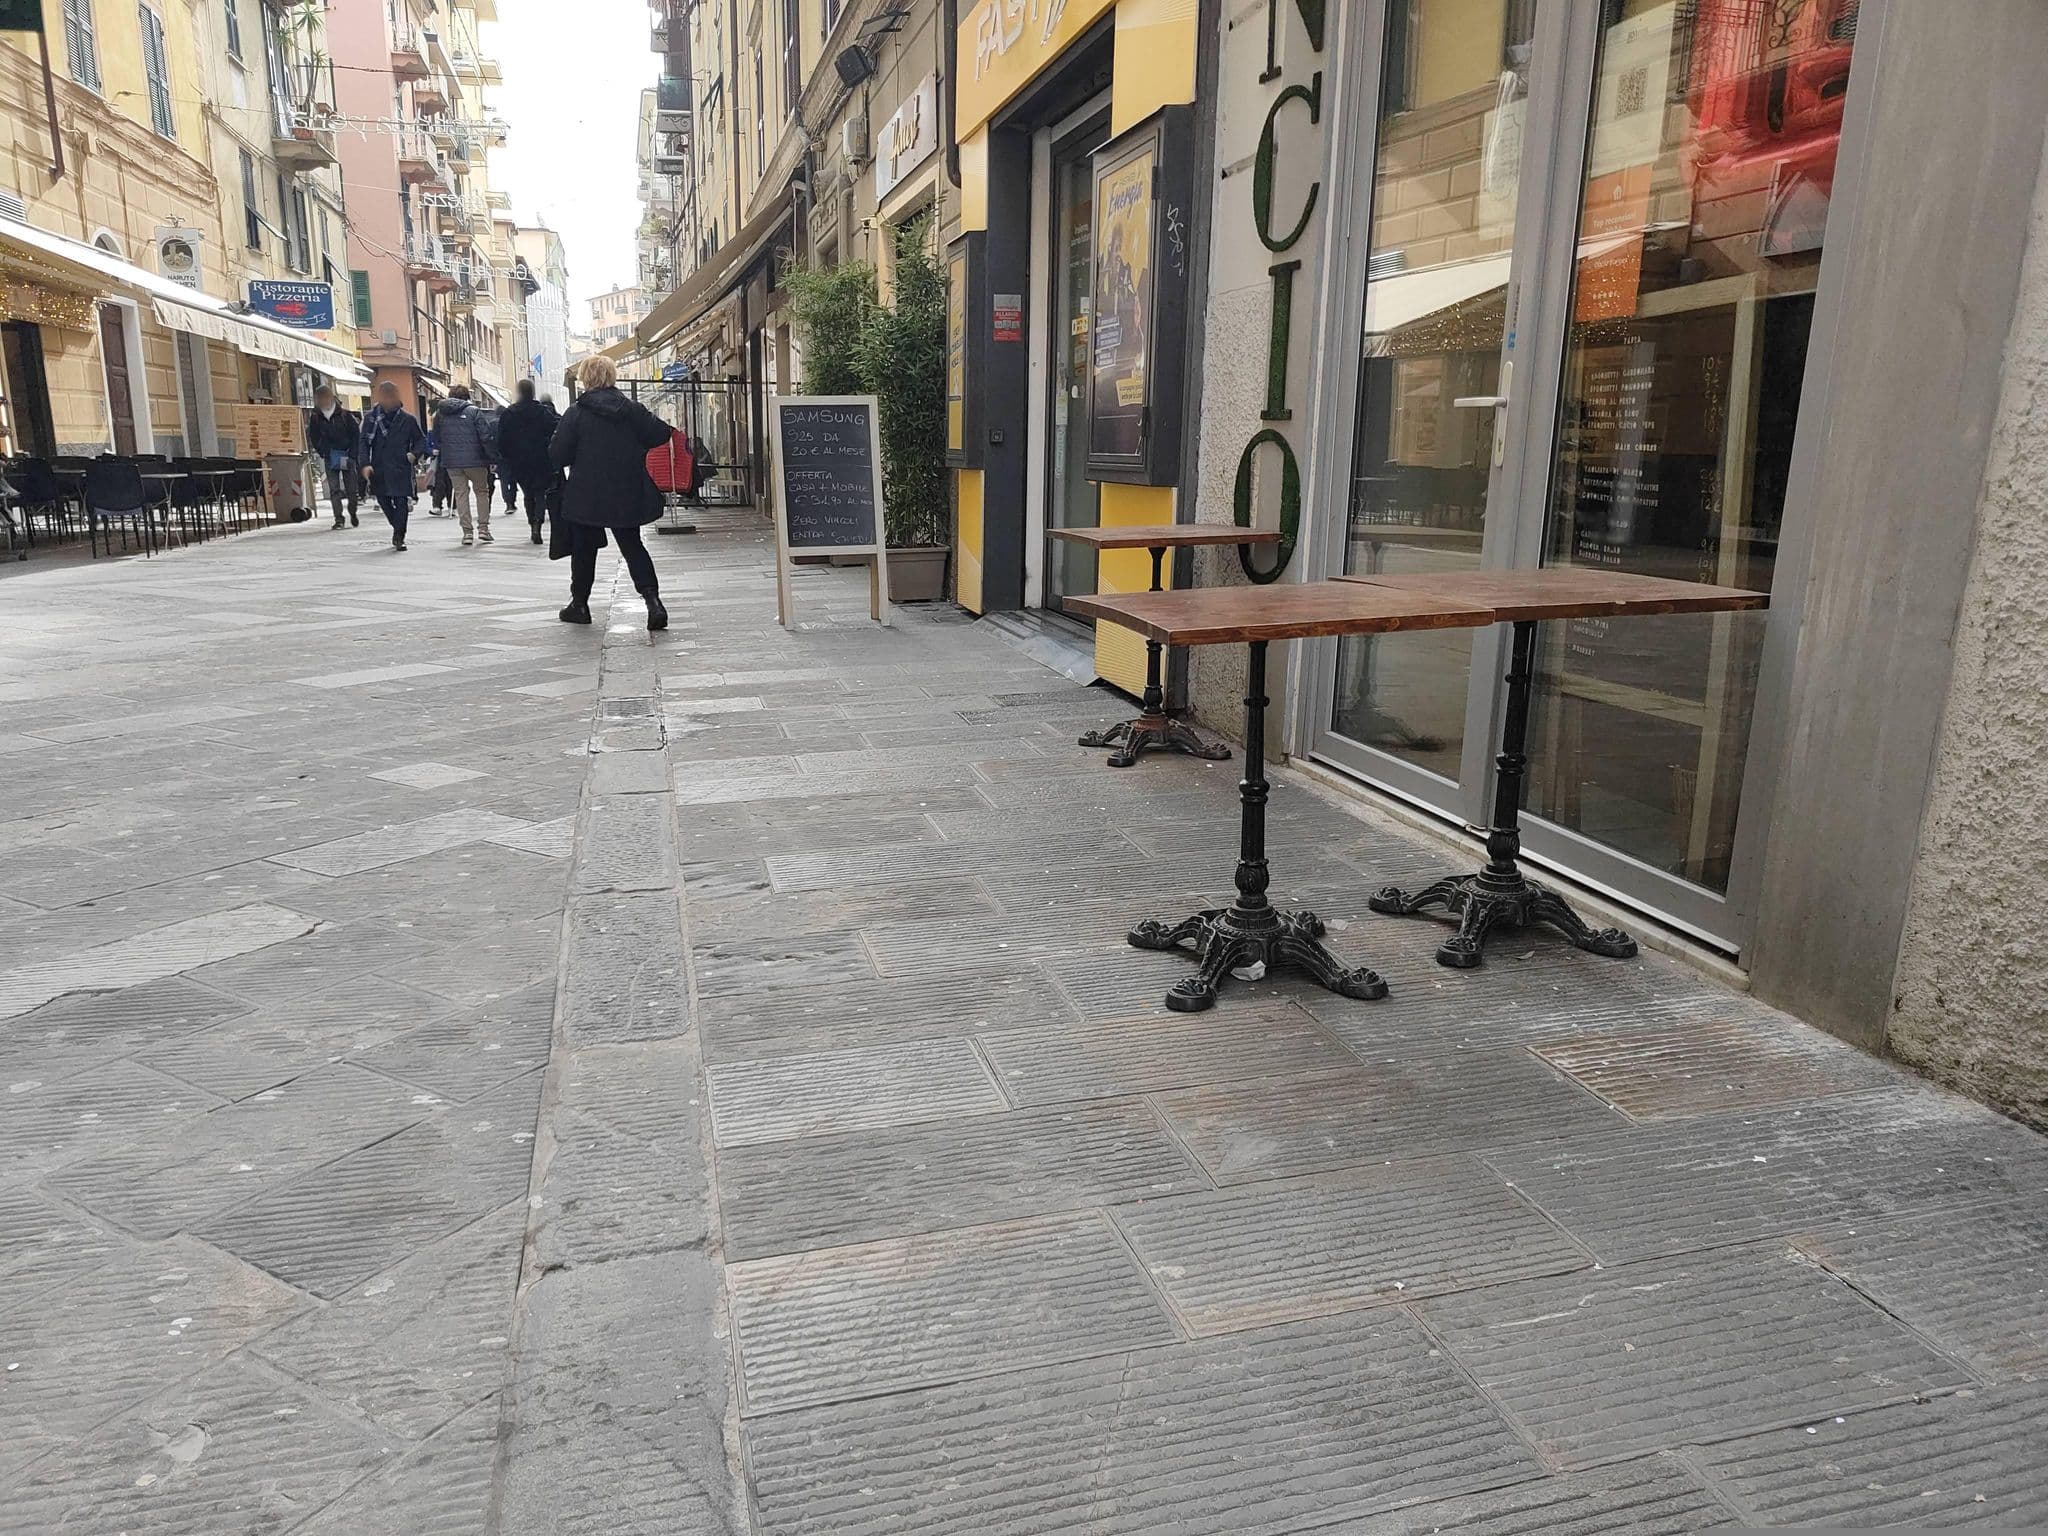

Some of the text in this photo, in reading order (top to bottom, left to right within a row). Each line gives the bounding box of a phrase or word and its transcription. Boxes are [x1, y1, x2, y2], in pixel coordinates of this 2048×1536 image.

[253, 281, 329, 295] Ristorante
[262, 290, 321, 303] Pizzeria
[823, 432, 840, 442] DA
[823, 447, 835, 455] AL
[838, 446, 865, 456] MESE
[786, 471, 833, 480] OFFERTA
[789, 483, 815, 492] CASA
